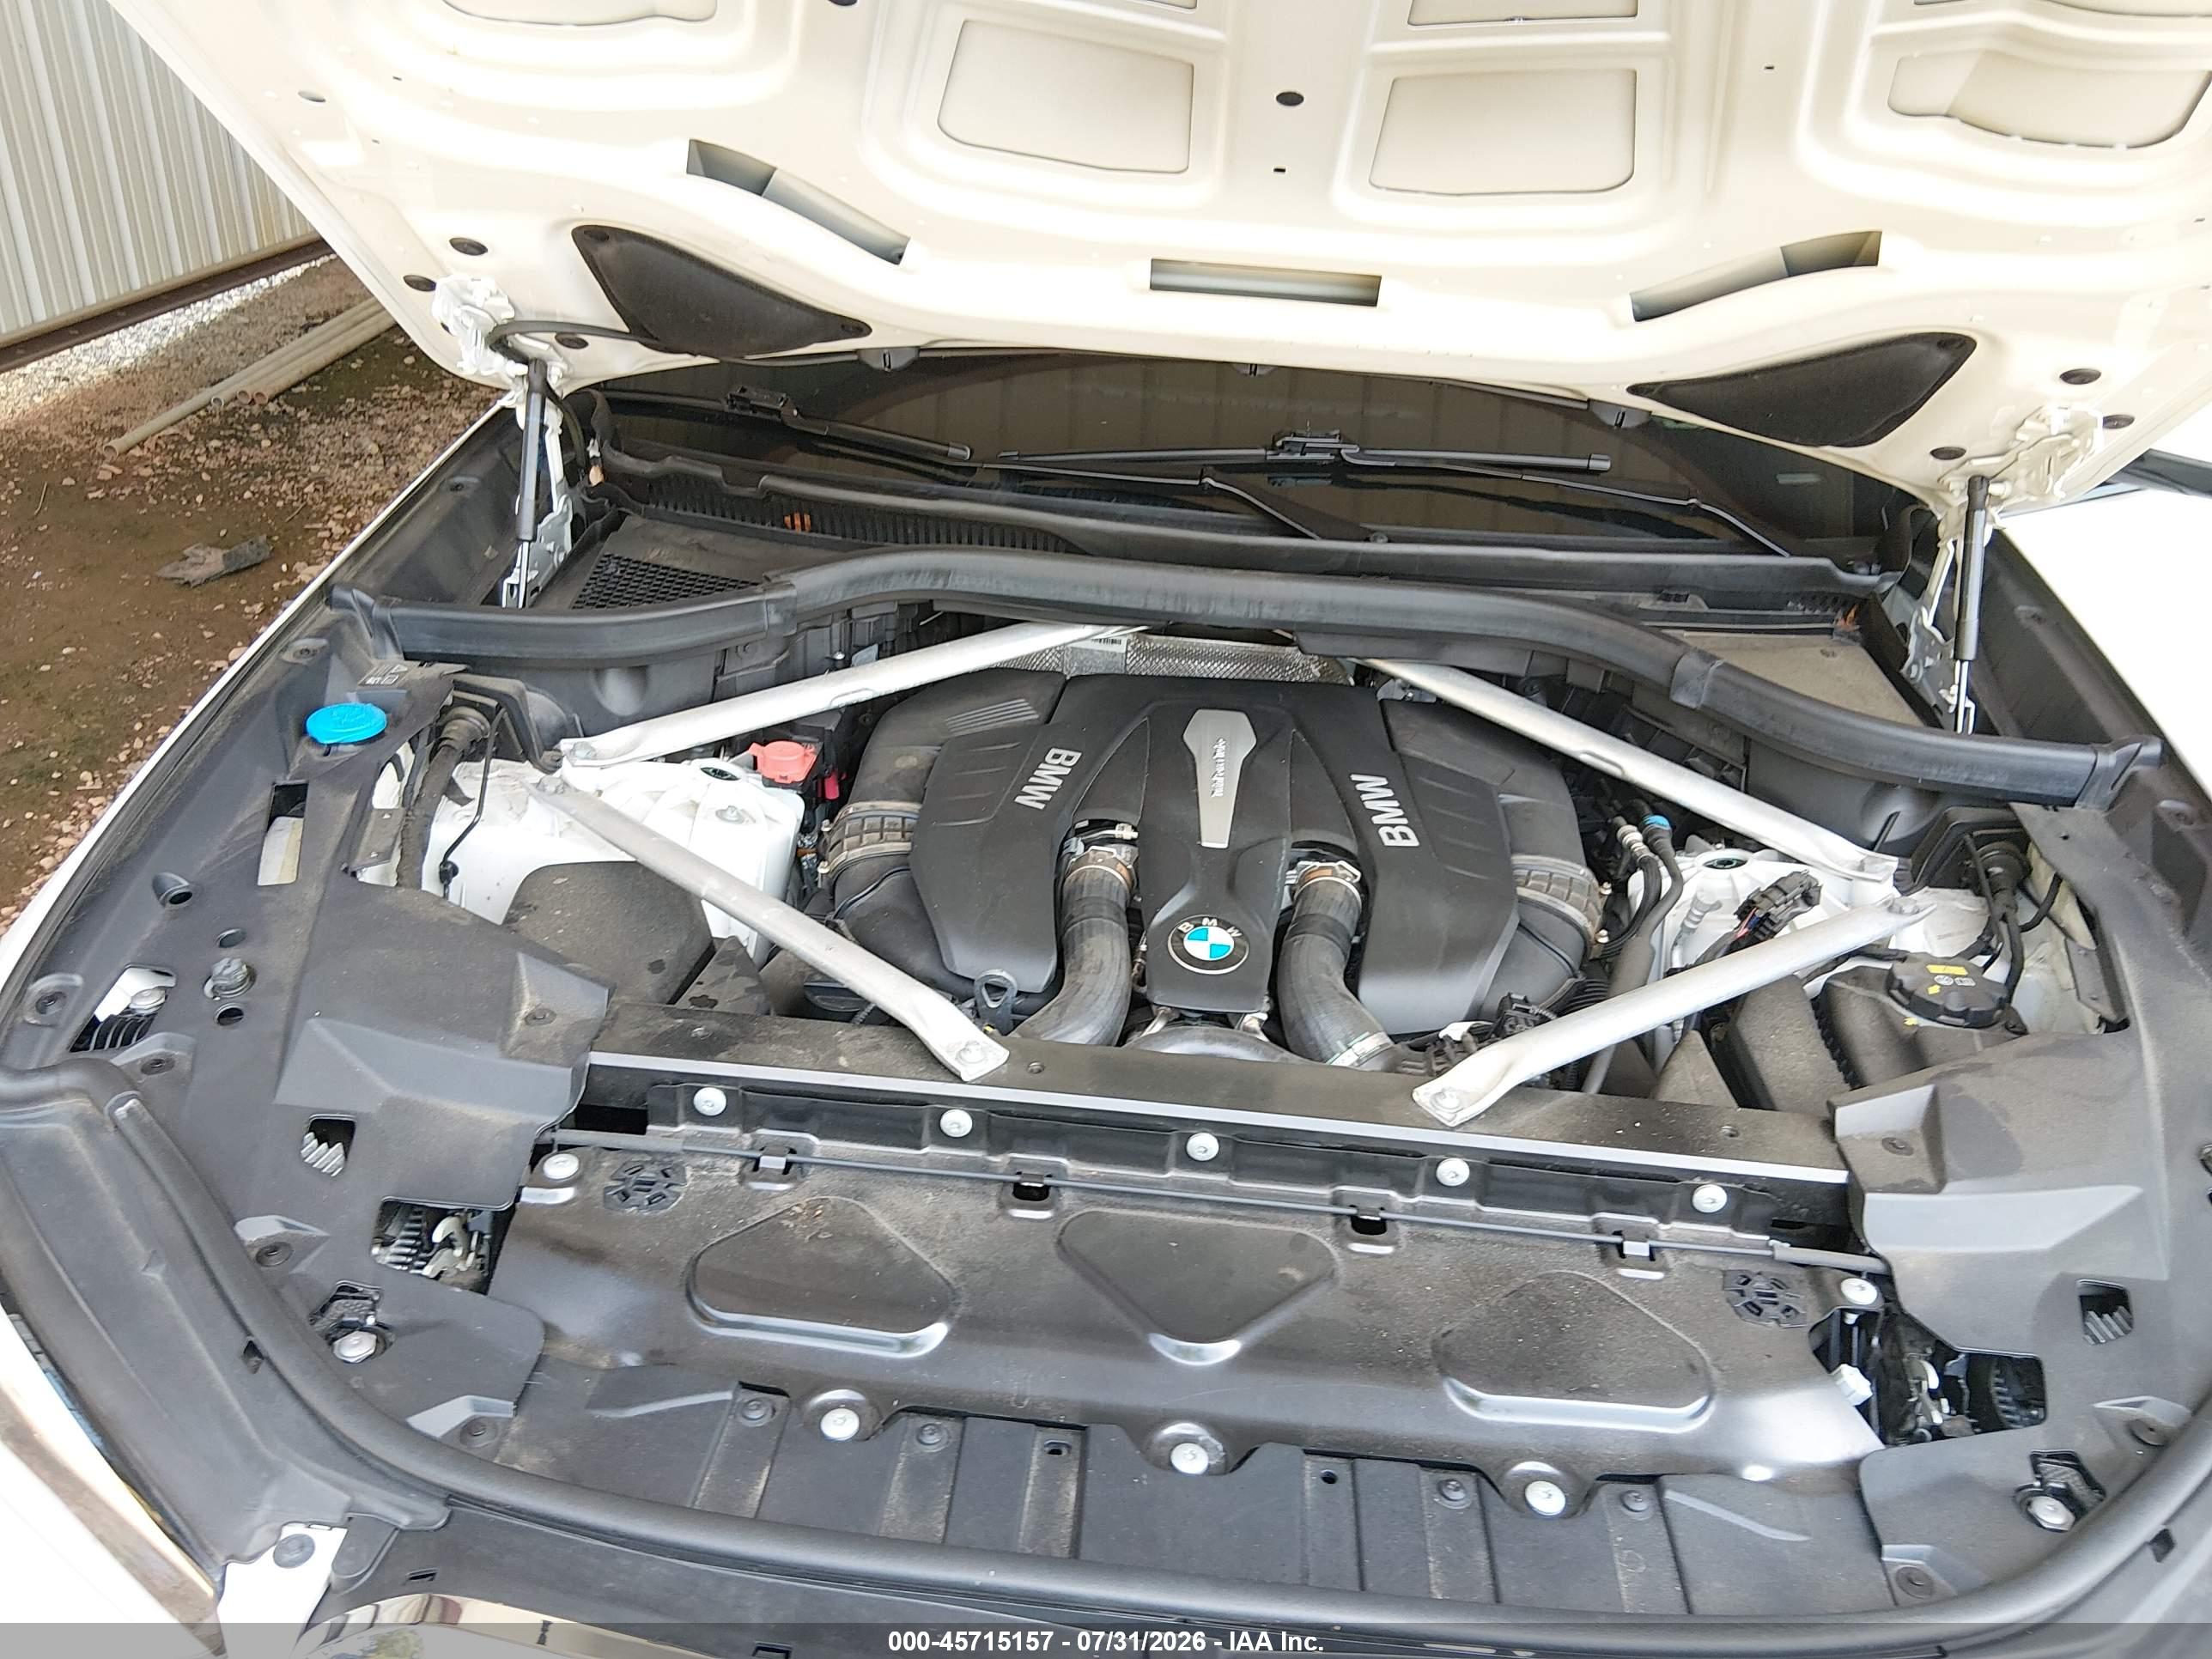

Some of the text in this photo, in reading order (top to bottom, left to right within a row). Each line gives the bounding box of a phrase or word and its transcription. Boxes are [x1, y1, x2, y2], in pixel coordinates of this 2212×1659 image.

[1014, 747, 1082, 810] BMW
[1350, 774, 1419, 847] BMW
[1177, 917, 1243, 938] BMW
